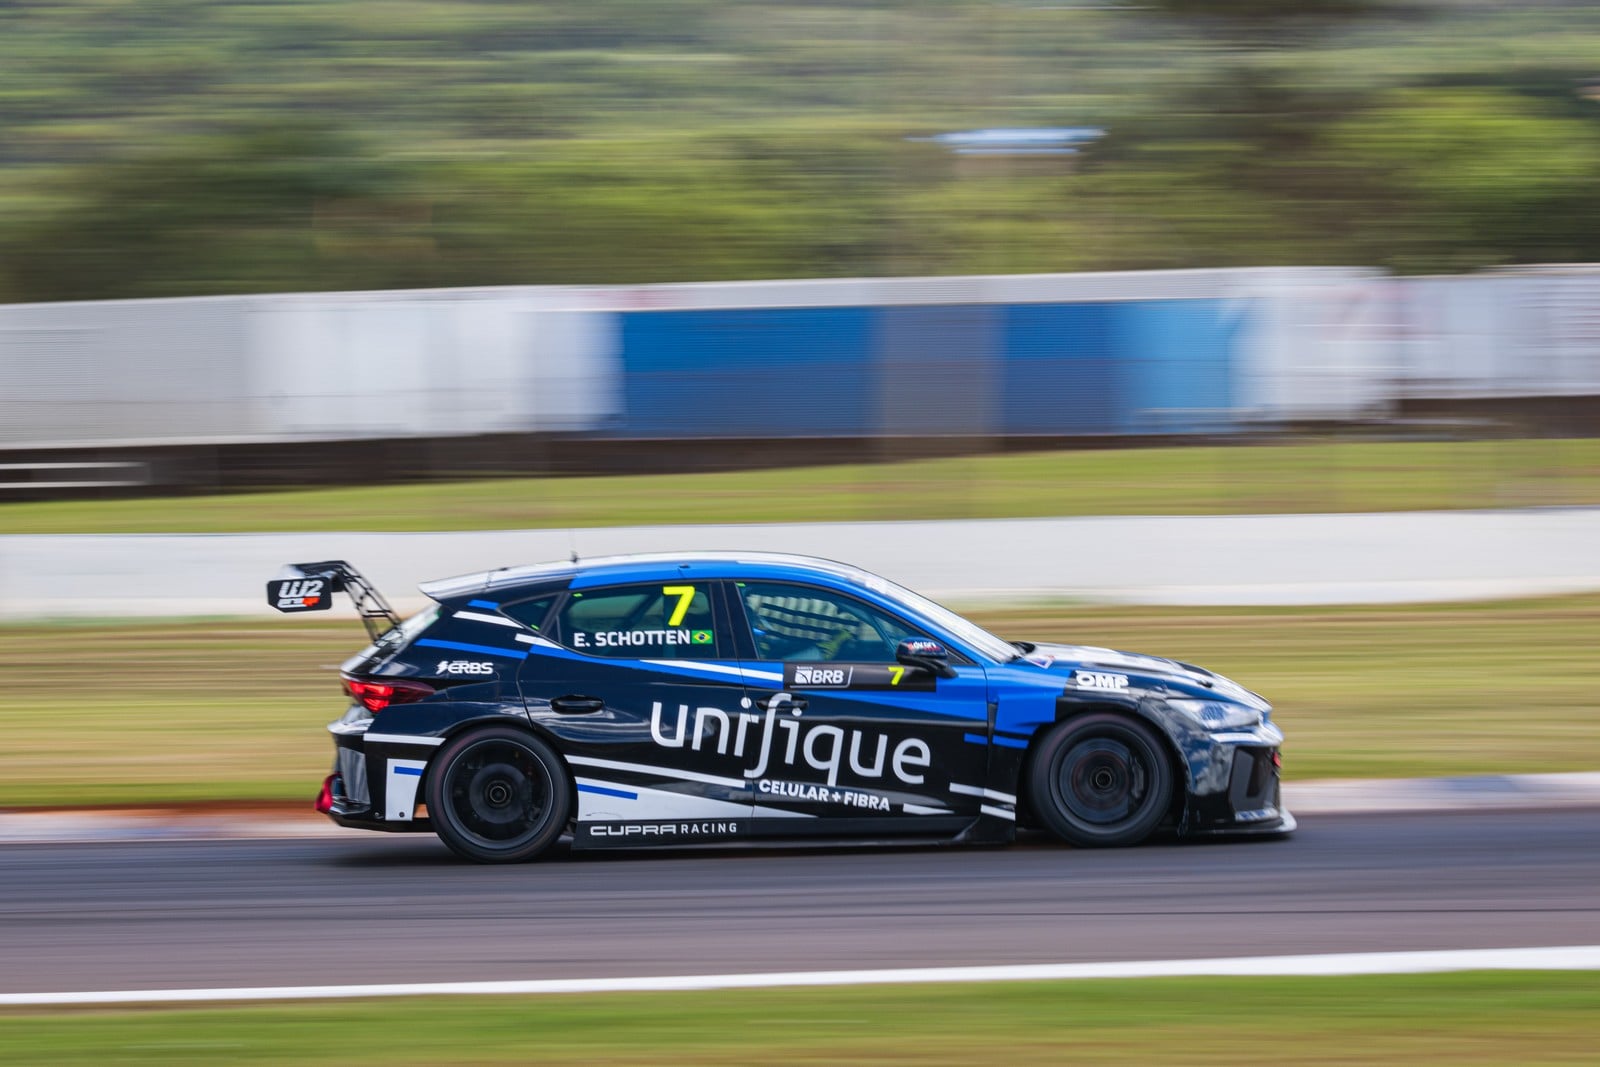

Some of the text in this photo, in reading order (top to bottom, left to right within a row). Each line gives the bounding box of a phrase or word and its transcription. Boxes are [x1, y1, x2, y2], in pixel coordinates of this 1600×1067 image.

[279, 580, 324, 598] W2
[662, 585, 696, 626] 7
[573, 630, 690, 647] E. SCHOTTEN
[447, 661, 494, 674] ERBS
[811, 669, 844, 684] BRB
[887, 666, 905, 685] 7
[1076, 671, 1129, 690] OMP
[650, 692, 931, 786] unifique
[759, 778, 829, 802] CELULAR
[843, 792, 890, 811] FIBRA
[590, 822, 738, 836] CUPRA RACING
